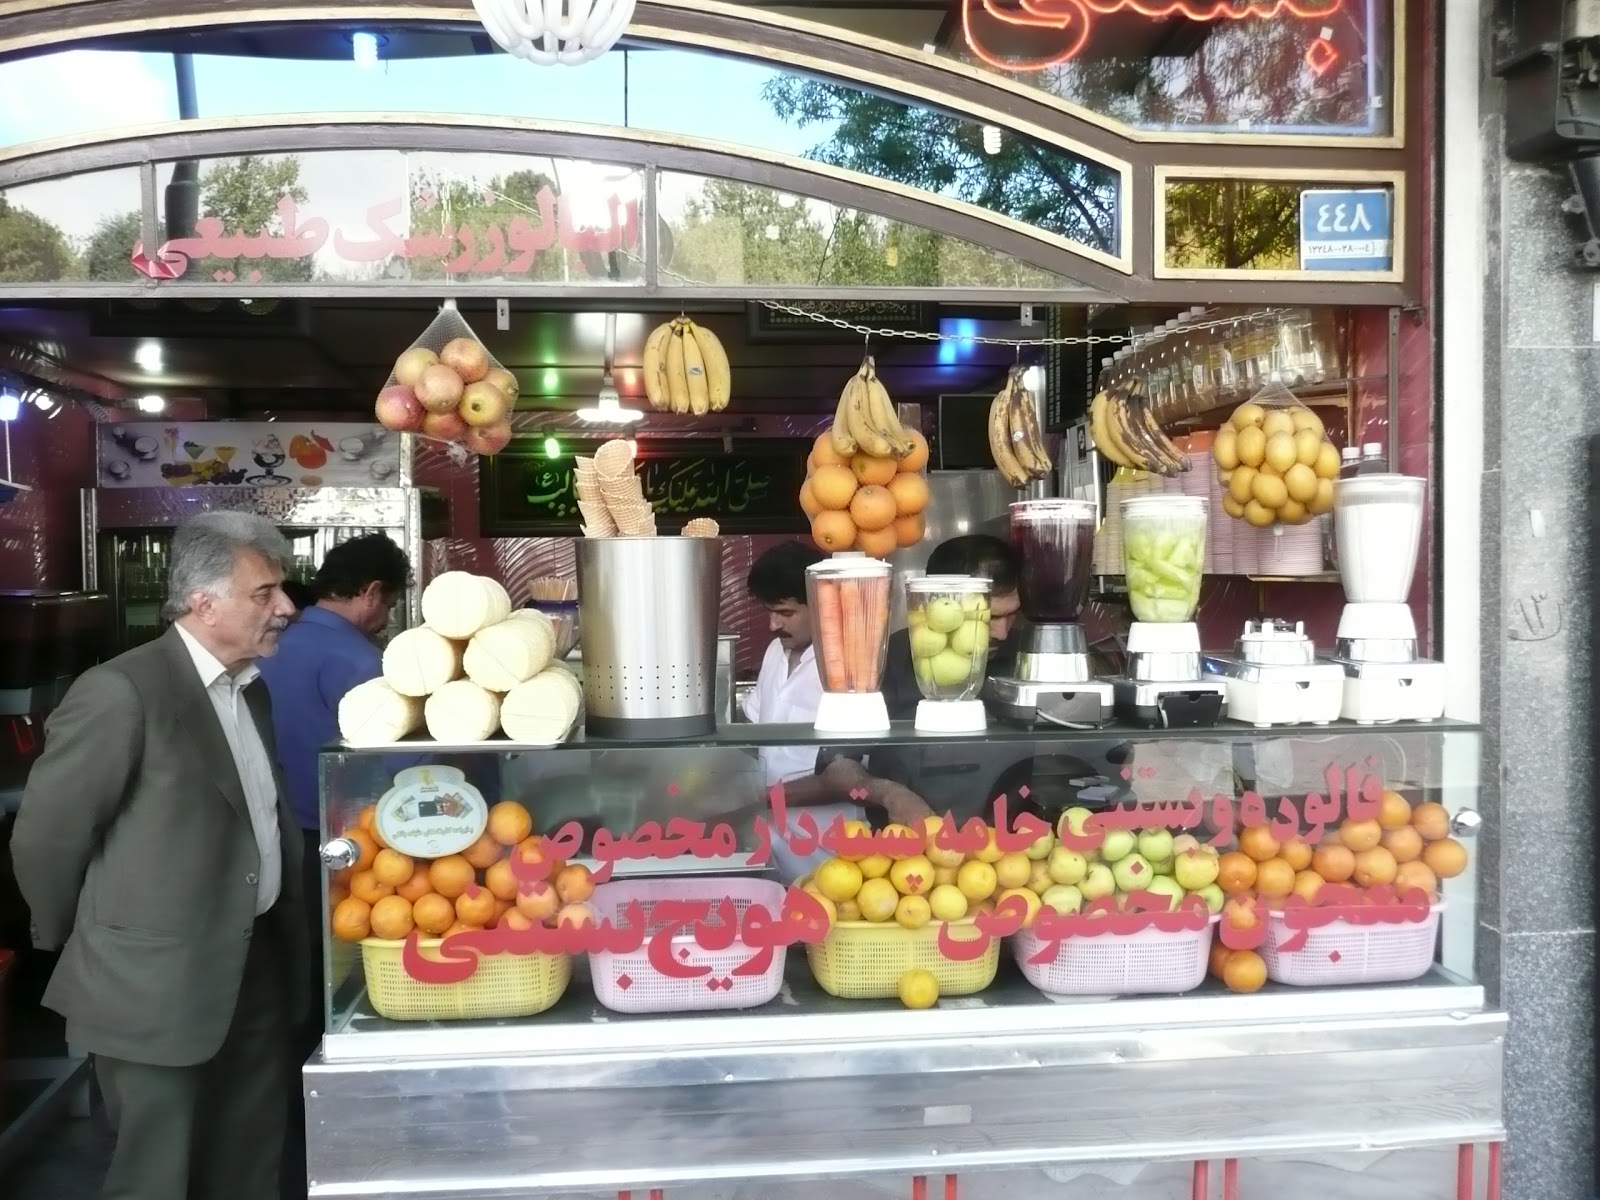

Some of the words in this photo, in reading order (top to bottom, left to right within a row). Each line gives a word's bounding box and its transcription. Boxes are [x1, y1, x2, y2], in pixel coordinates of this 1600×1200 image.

[131, 192, 330, 284] طبیعی
[511, 783, 737, 896] مخصوص
[935, 785, 1052, 853] خامه
[1060, 766, 1202, 857] بستنی
[1240, 755, 1384, 844] فالوده
[402, 884, 646, 991] بستنی
[647, 884, 832, 991] هویج
[938, 861, 1209, 965] مخصوص
[1220, 883, 1431, 964] معجون
